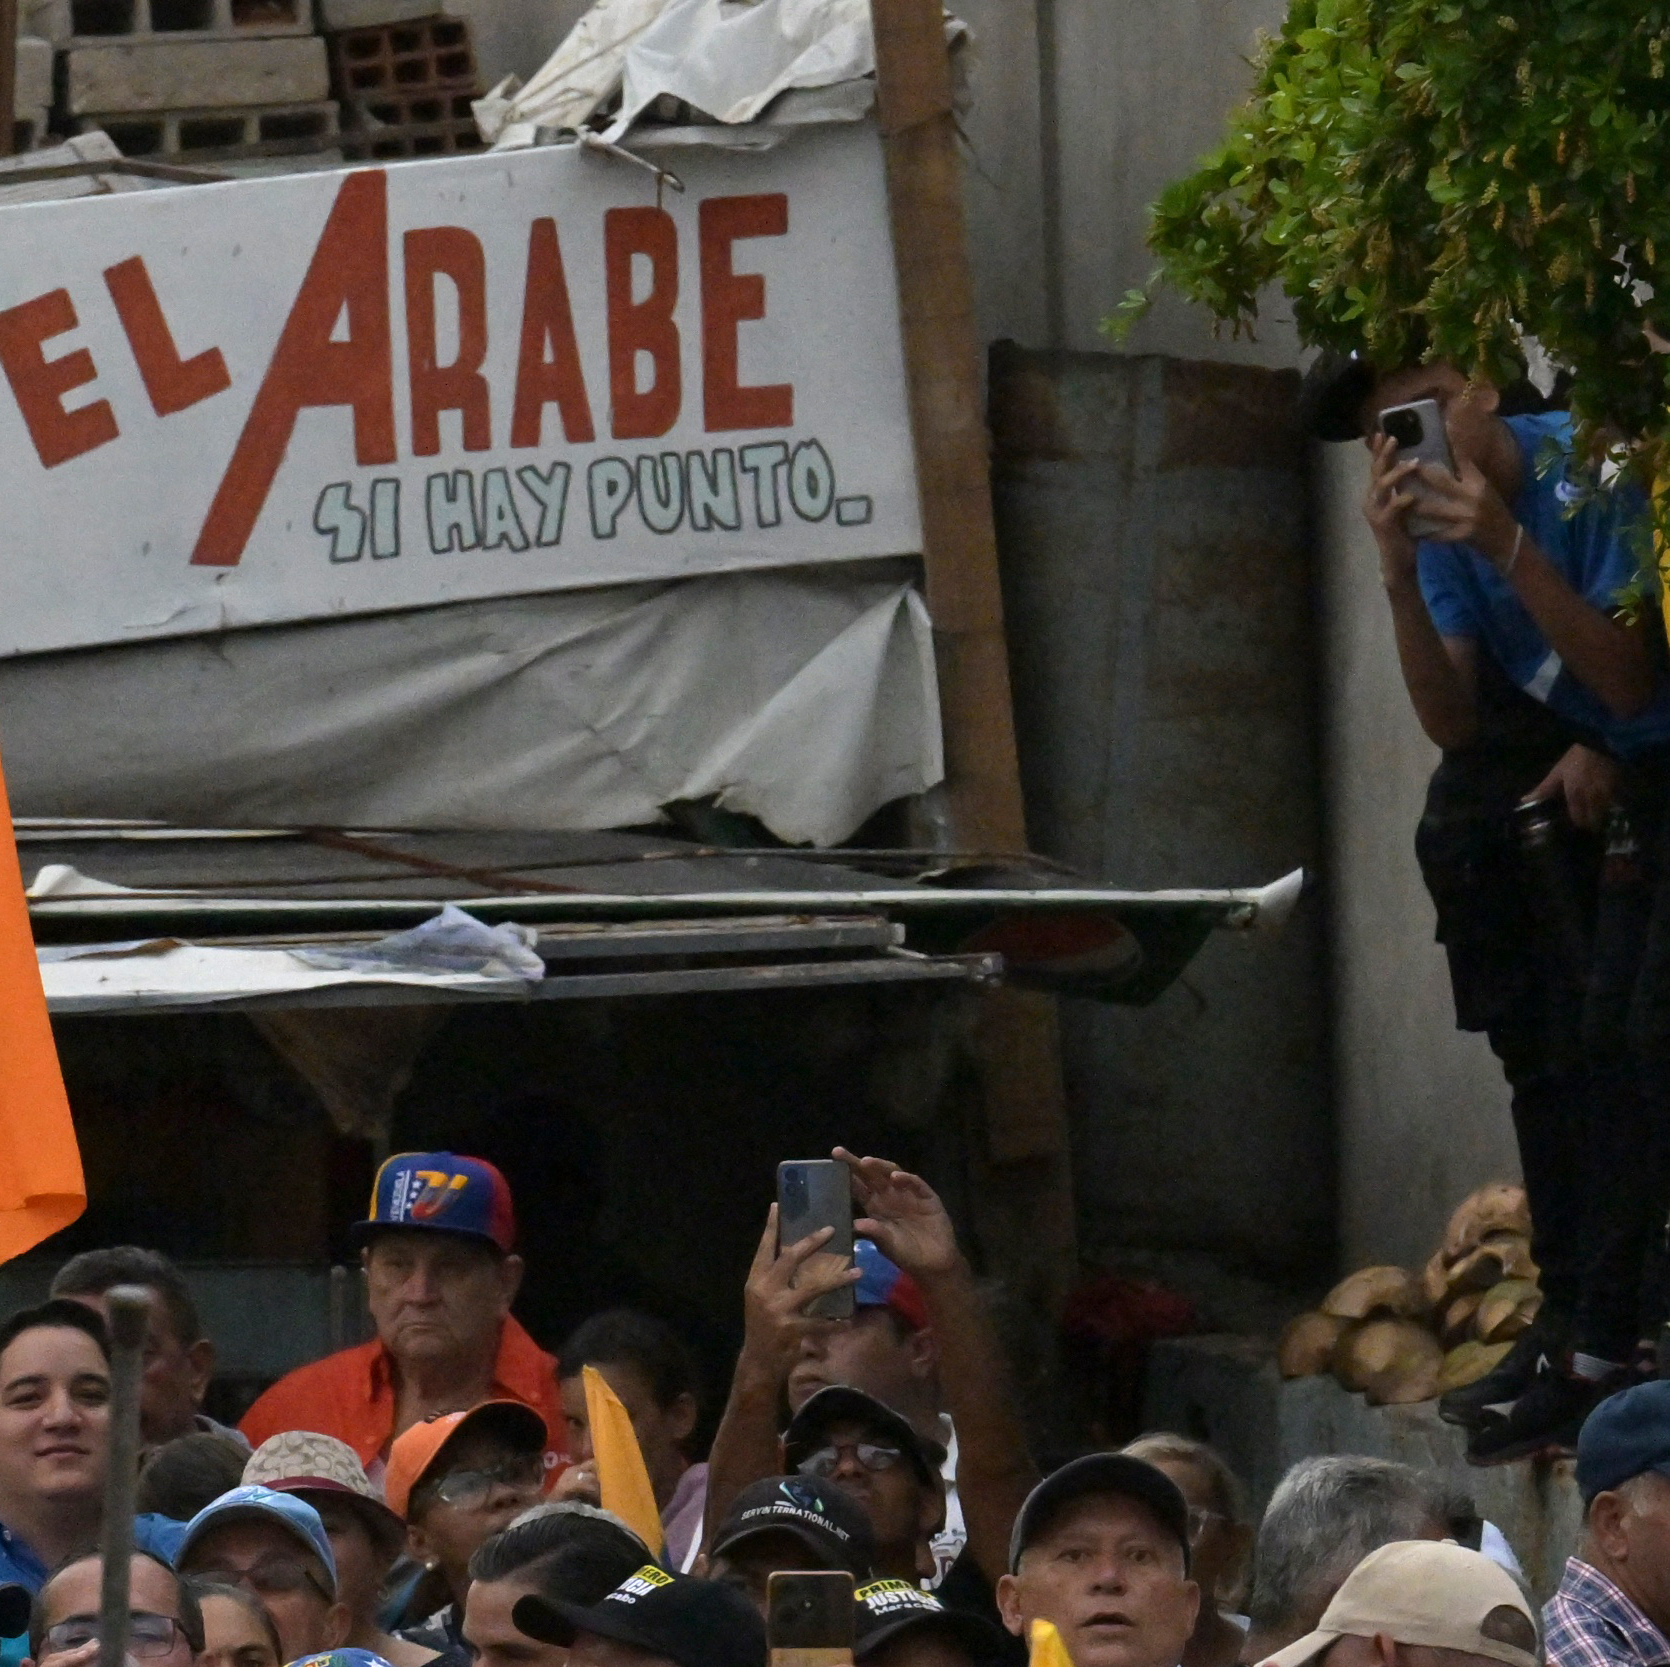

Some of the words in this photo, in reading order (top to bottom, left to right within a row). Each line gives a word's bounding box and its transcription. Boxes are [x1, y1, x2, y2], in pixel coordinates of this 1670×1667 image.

[187, 168, 795, 568] ARABE
[312, 477, 400, 564] SI
[427, 461, 581, 555] HAY
